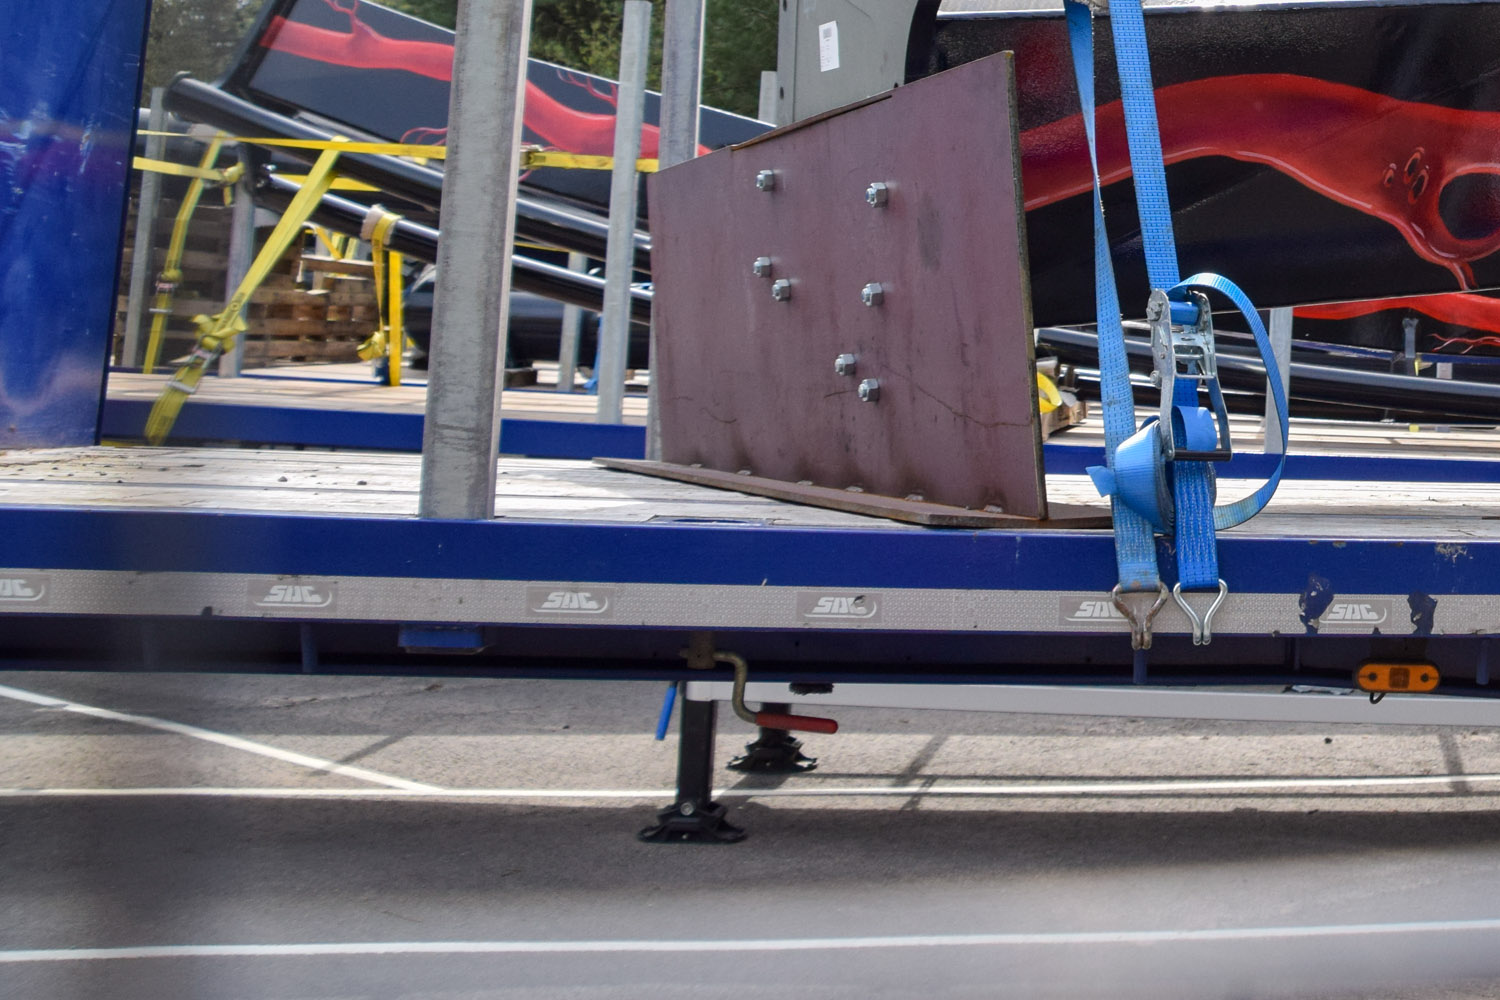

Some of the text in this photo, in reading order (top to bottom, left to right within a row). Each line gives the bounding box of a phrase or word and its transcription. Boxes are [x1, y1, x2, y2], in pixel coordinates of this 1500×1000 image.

[260, 585, 323, 602] SDC
[540, 592, 599, 608] SDC
[811, 597, 868, 613] SDC
[1329, 603, 1380, 618] SDC
